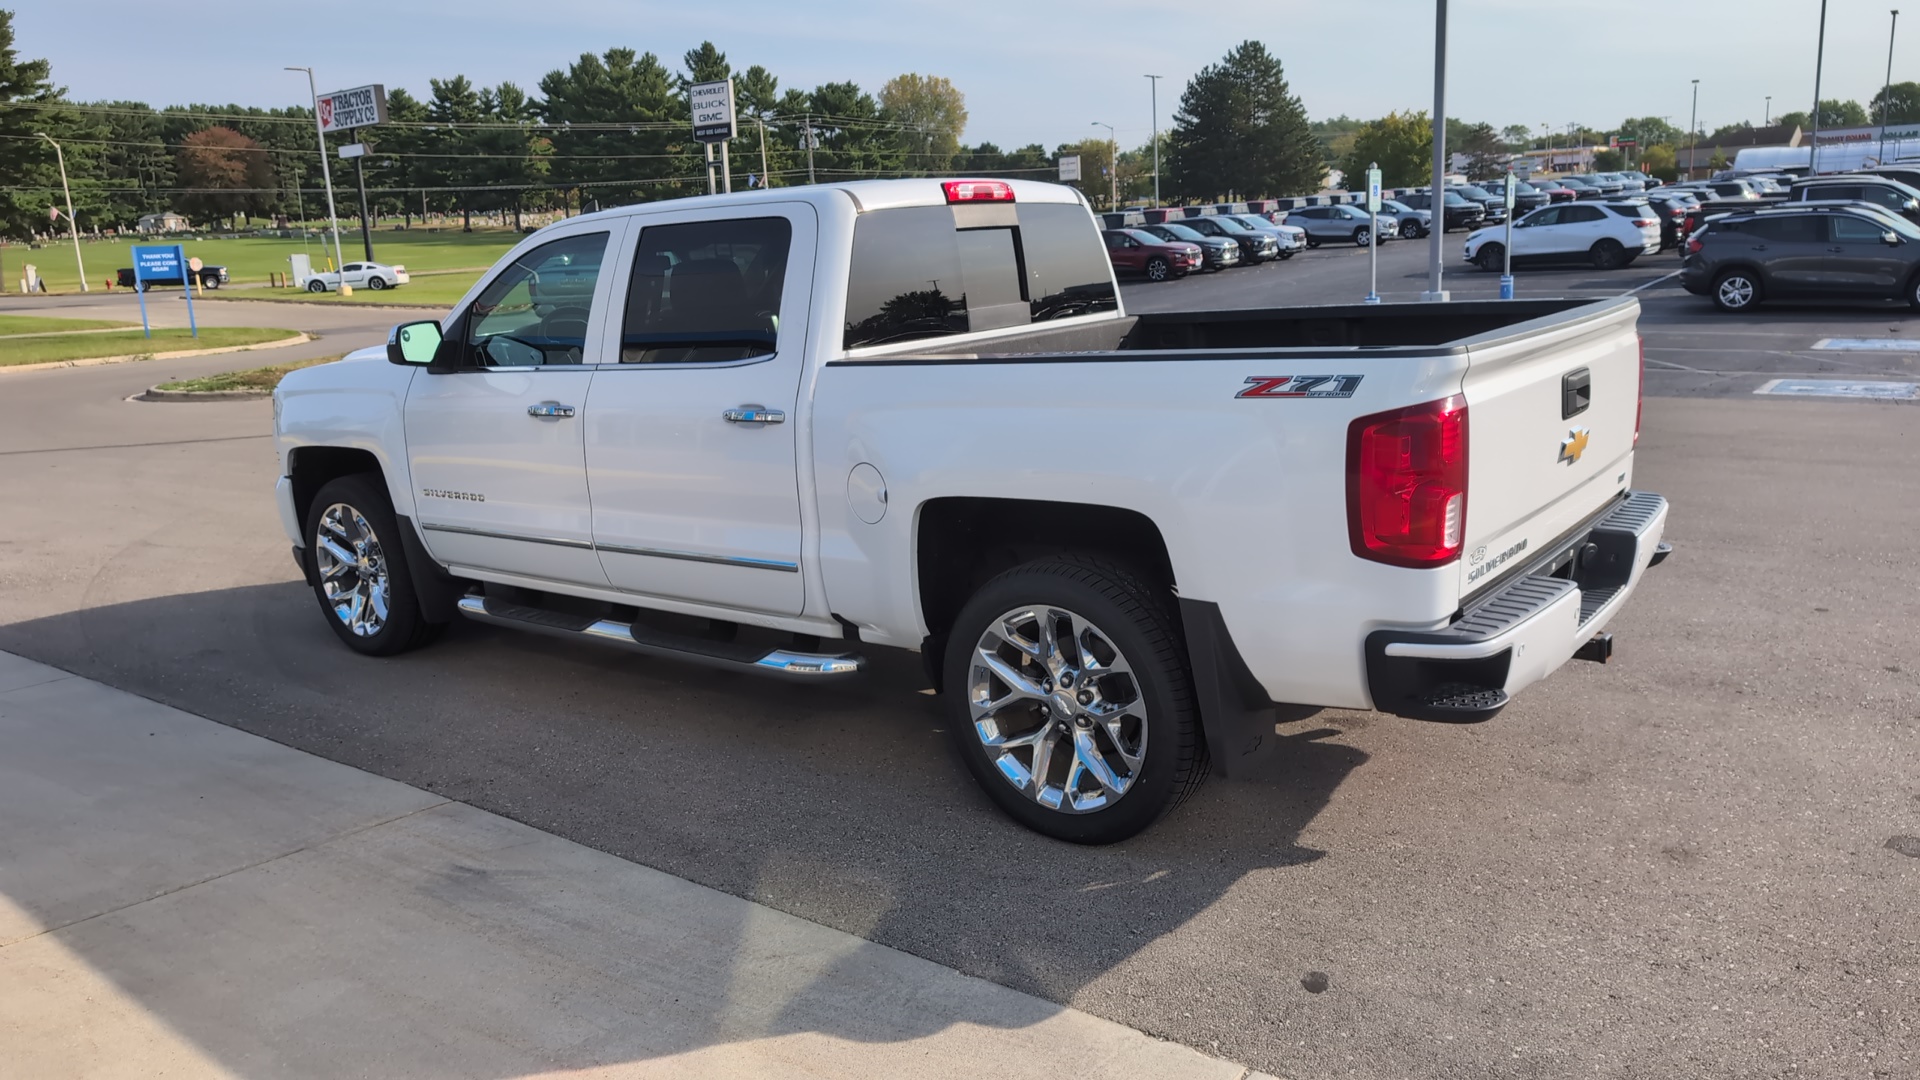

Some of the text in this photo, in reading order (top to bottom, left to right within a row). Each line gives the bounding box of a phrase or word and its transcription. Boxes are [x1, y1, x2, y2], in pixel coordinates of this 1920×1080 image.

[332, 89, 372, 111] TRACTOR
[692, 86, 725, 97] CHEVROLET
[693, 99, 726, 110] BUICK
[334, 107, 364, 127] SUPPLY
[698, 112, 723, 122] GMC
[1234, 374, 1365, 399] Z71
[423, 488, 485, 502] SILVERADO
[1467, 538, 1528, 585] SILVERADO
